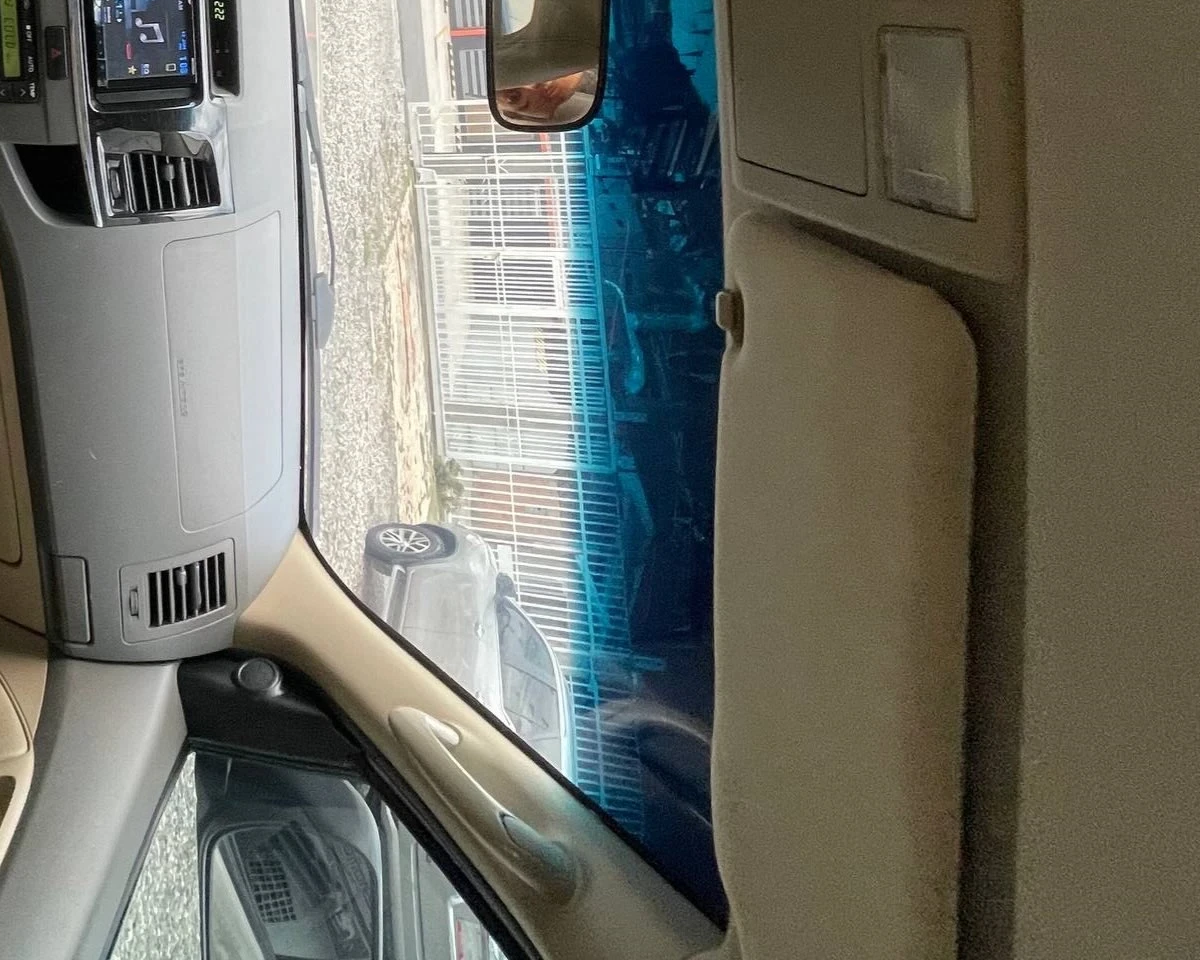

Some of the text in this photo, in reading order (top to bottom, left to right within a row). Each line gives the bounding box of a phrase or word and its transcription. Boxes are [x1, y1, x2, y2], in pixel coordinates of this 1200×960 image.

[177, 0, 184, 11] AM
[27, 55, 35, 73] AUTO
[28, 82, 36, 98] TEMP
